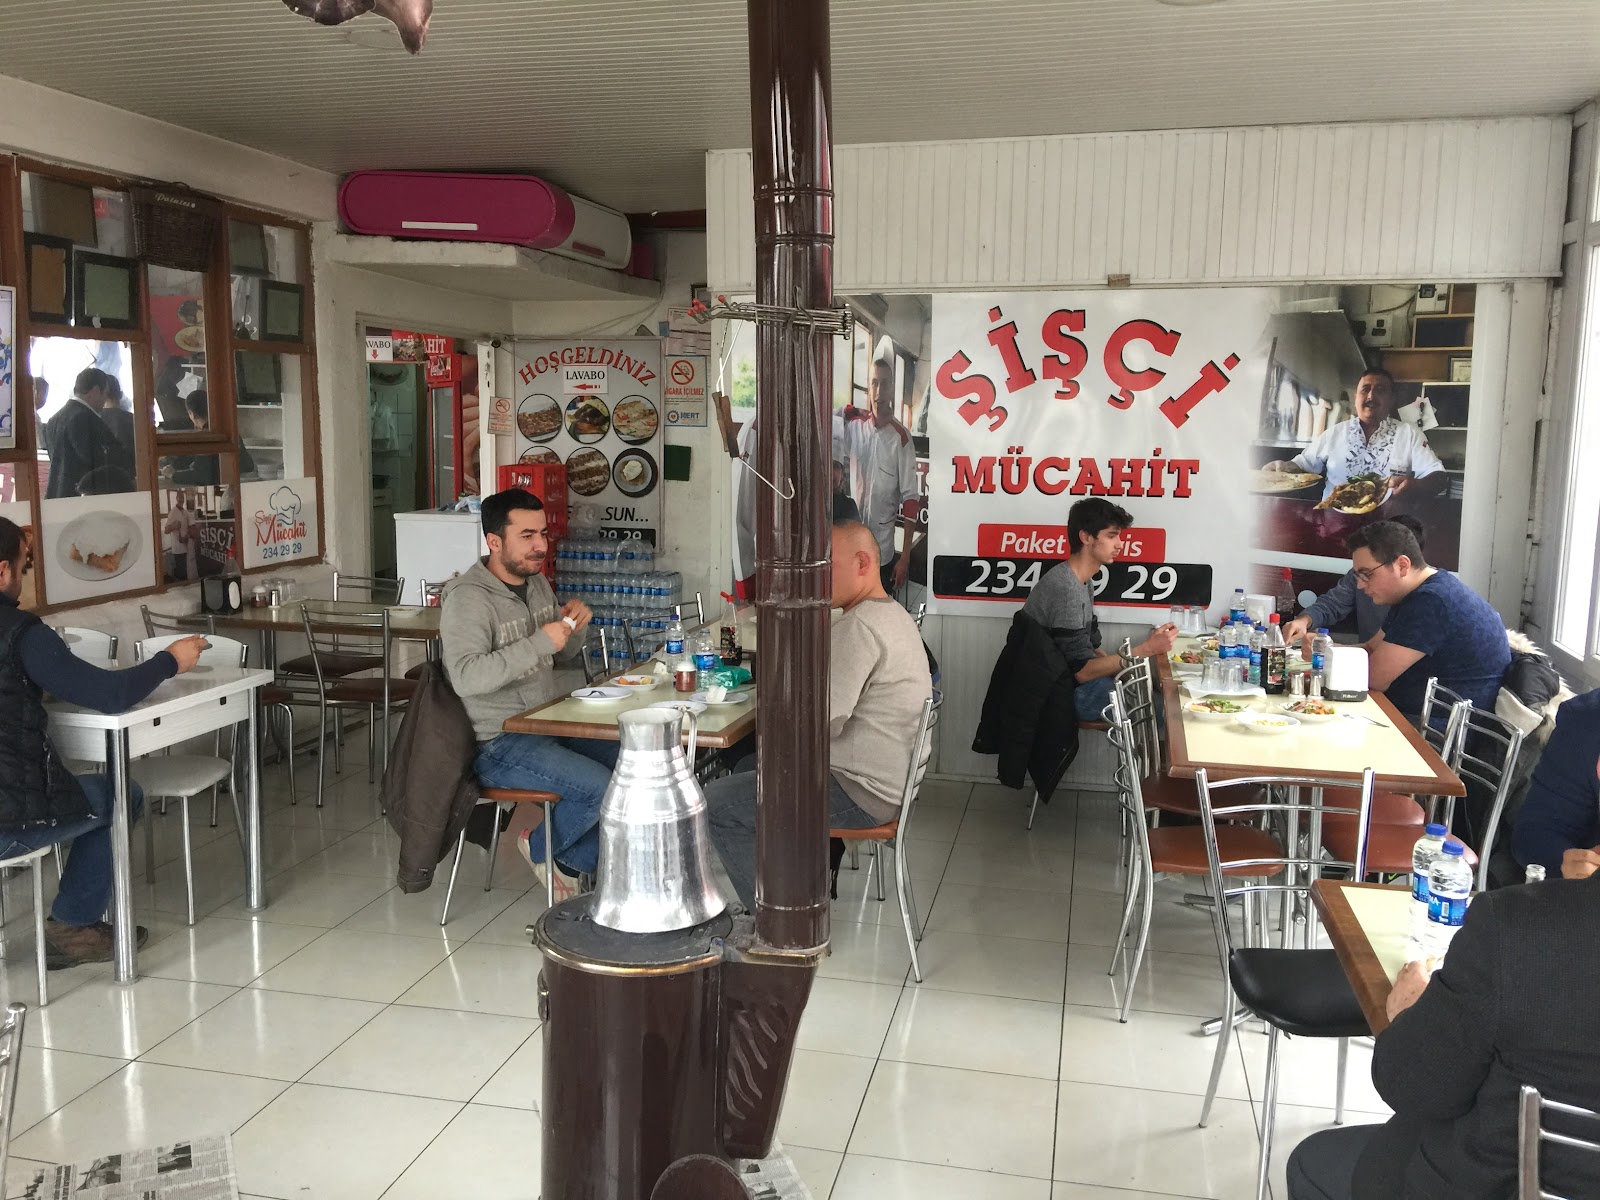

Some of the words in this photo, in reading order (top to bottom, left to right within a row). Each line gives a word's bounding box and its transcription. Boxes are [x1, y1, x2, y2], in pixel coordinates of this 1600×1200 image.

[366, 340, 391, 349] AVABO
[518, 346, 657, 387] HOŞGELDİNİZ
[565, 370, 606, 381] LAVABO
[936, 305, 1241, 433] ŞİŞÇİ
[952, 446, 1200, 498] MÜCAHİT
[263, 546, 278, 560] 234
[280, 544, 290, 556] 29
[292, 542, 302, 554] 29
[1000, 531, 1066, 555] Paket
[965, 559, 1042, 594] 234
[1120, 565, 1178, 601] 29
